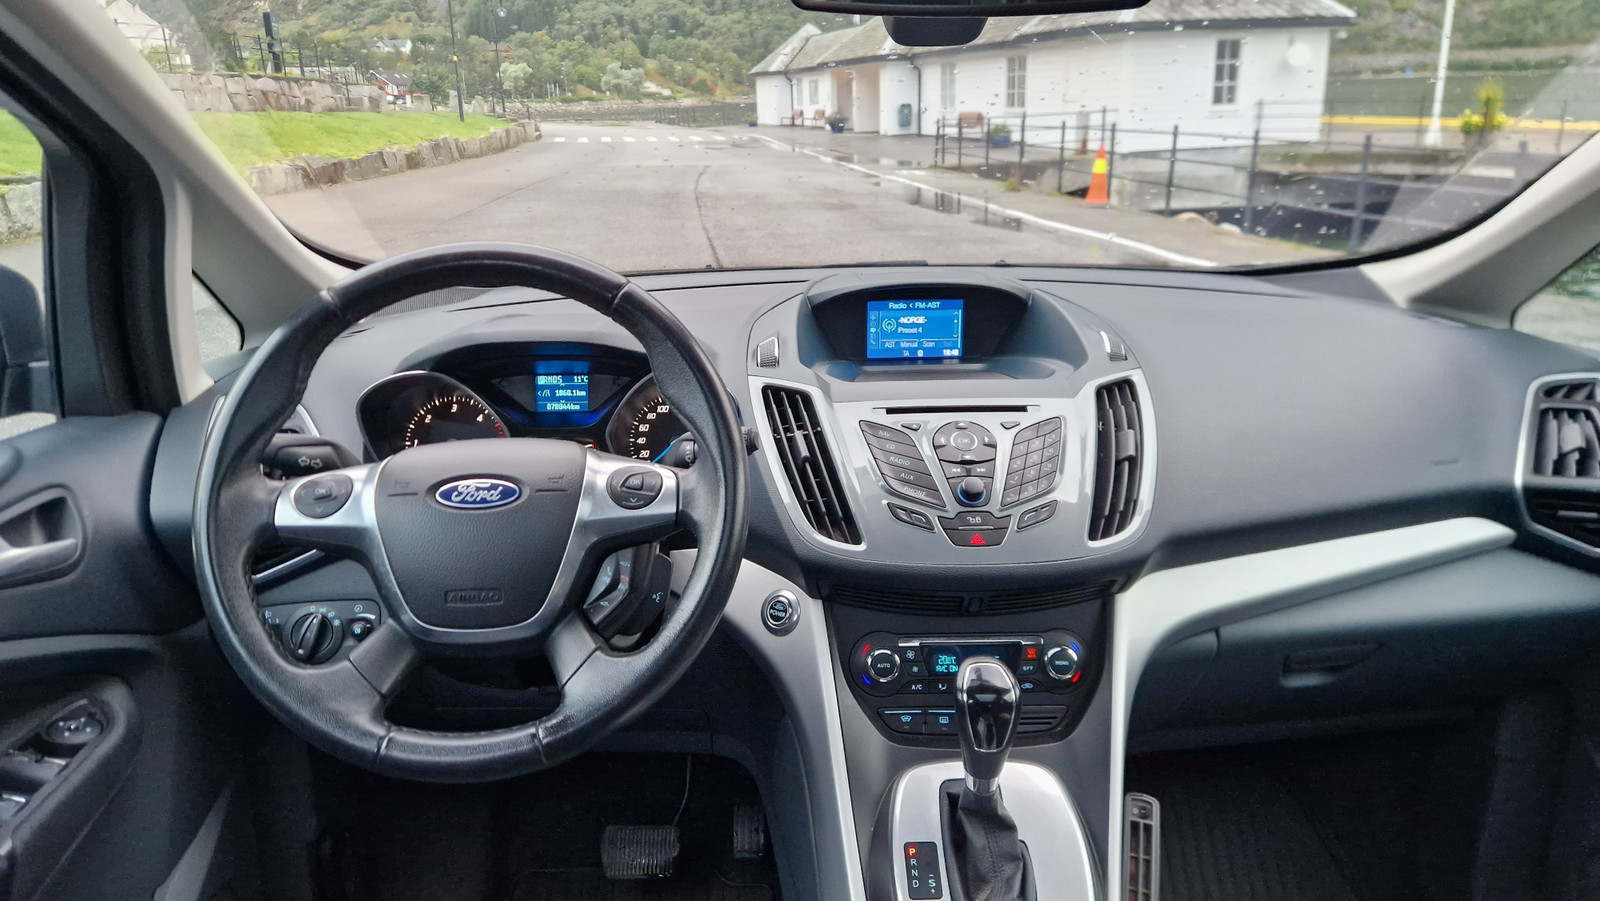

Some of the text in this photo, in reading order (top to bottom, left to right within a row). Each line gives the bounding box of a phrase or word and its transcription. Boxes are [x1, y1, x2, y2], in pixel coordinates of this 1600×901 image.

[451, 404, 457, 412] 3
[425, 414, 432, 423] 2
[476, 414, 483, 422] 4
[890, 456, 910, 466] RADIO
[452, 482, 503, 502] Ford
[904, 486, 927, 496] PHONE
[770, 609, 786, 618] POWER
